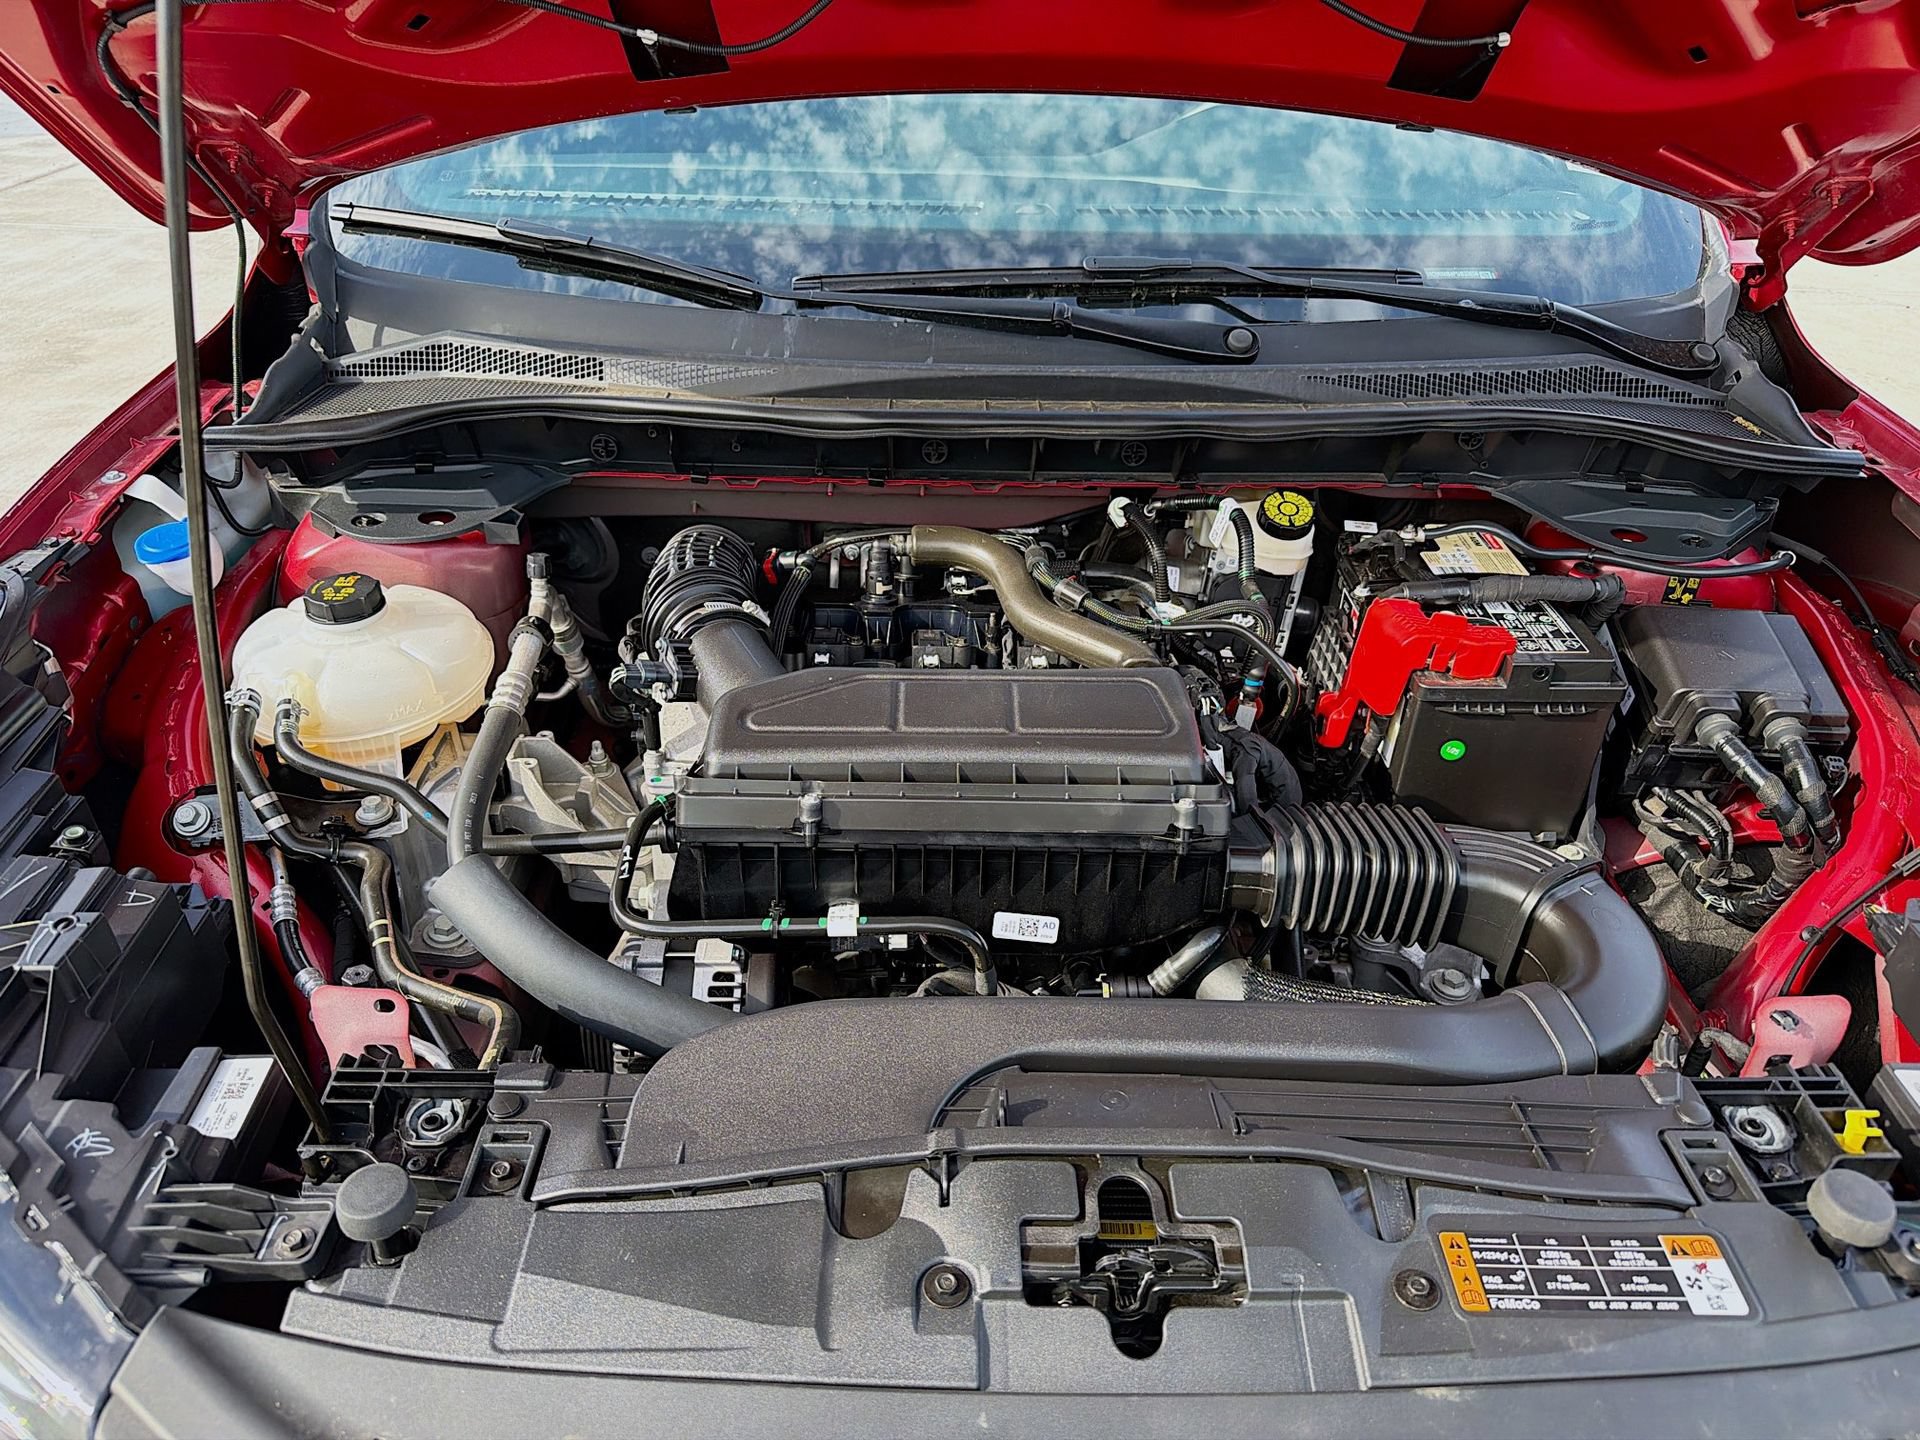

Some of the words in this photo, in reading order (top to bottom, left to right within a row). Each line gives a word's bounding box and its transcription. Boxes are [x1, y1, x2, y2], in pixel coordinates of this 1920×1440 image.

[1042, 921, 1056, 930] AD
[1482, 1275, 1503, 1284] PAG
[1489, 1298, 1541, 1310] FoMoCo
